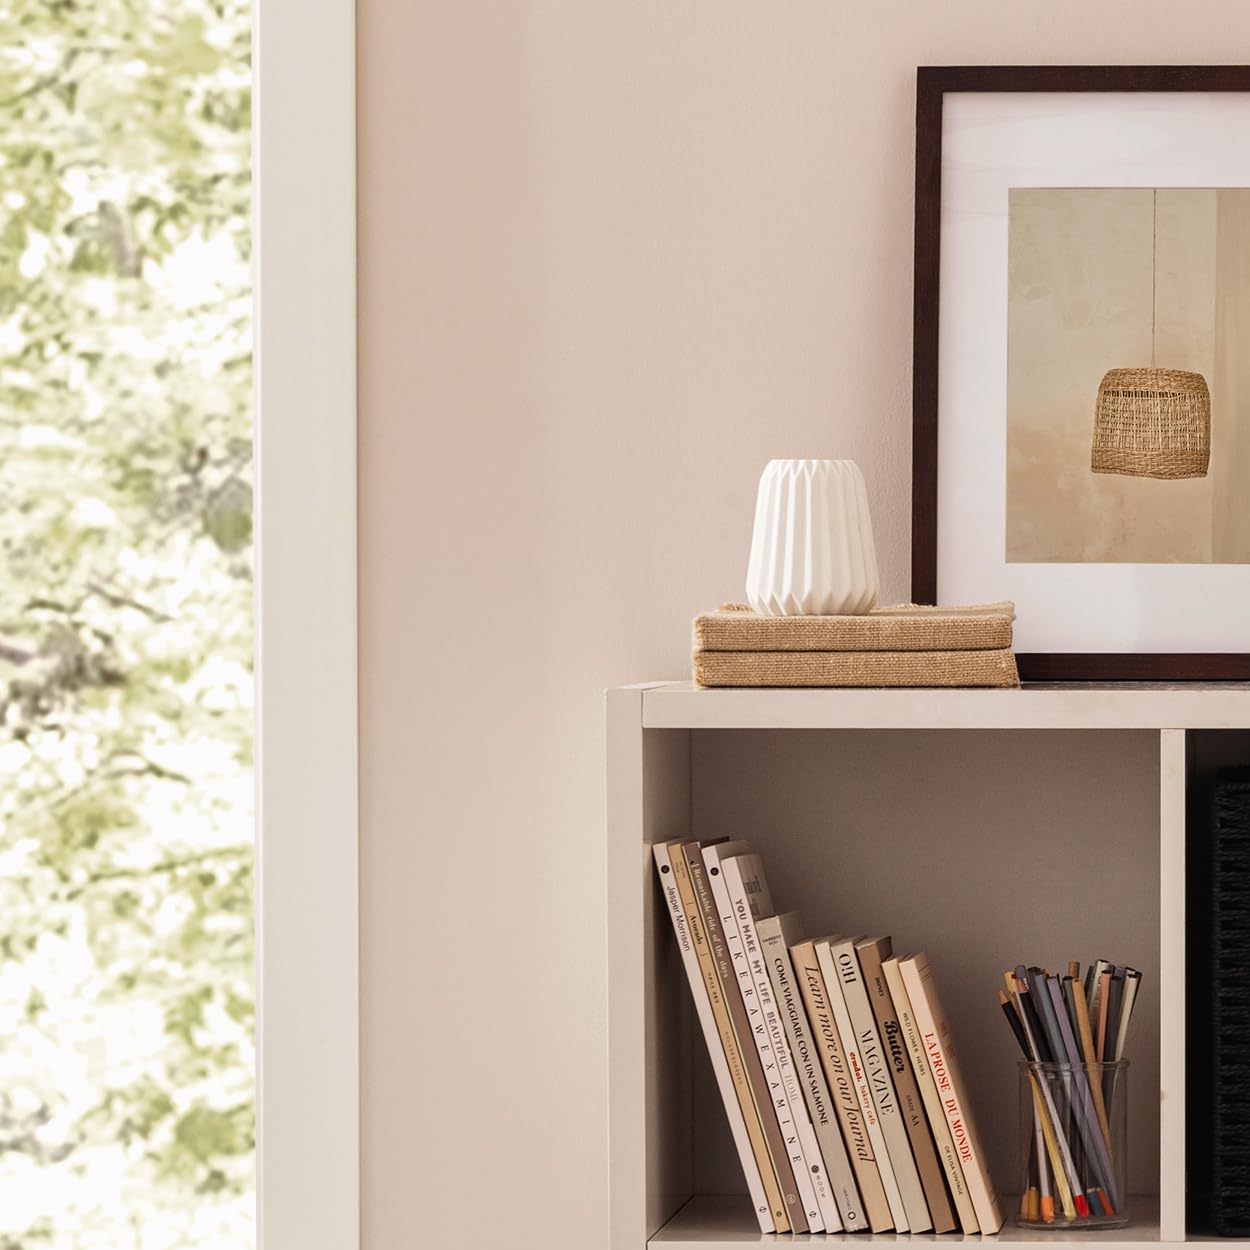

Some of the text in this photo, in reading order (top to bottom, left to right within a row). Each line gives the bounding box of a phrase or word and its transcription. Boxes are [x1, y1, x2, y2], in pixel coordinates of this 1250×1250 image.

[694, 869, 711, 912] Remarkable
[667, 886, 690, 951] Jasper Morrison
[707, 917, 716, 930] ride
[714, 945, 724, 957] the
[718, 960, 730, 978] days
[736, 899, 747, 920] YOU
[743, 925, 756, 952] MAKE
[752, 960, 762, 974] MY
[759, 982, 771, 1004] LIFE
[767, 1011, 789, 1069] BEAUTIFUL
[784, 1075, 798, 1103] HOME
[774, 958, 829, 1125] COME VIAGGIARE CON UN SALMONE
[838, 953, 893, 1115] O!H MAGAZINE
[883, 1019, 906, 1074] Butter
[903, 1012, 925, 1076] WILD FLOWER HERBS
[925, 1032, 937, 1051] LA
[805, 967, 875, 1163] Learn more on our Journal
[930, 1051, 950, 1093] PROSE
[860, 1085, 870, 1108] bakery
[944, 1098, 958, 1117] DU
[952, 1118, 972, 1163] MONDE
[947, 1155, 955, 1170] ELISA
[953, 1171, 963, 1195] VINTAGE
